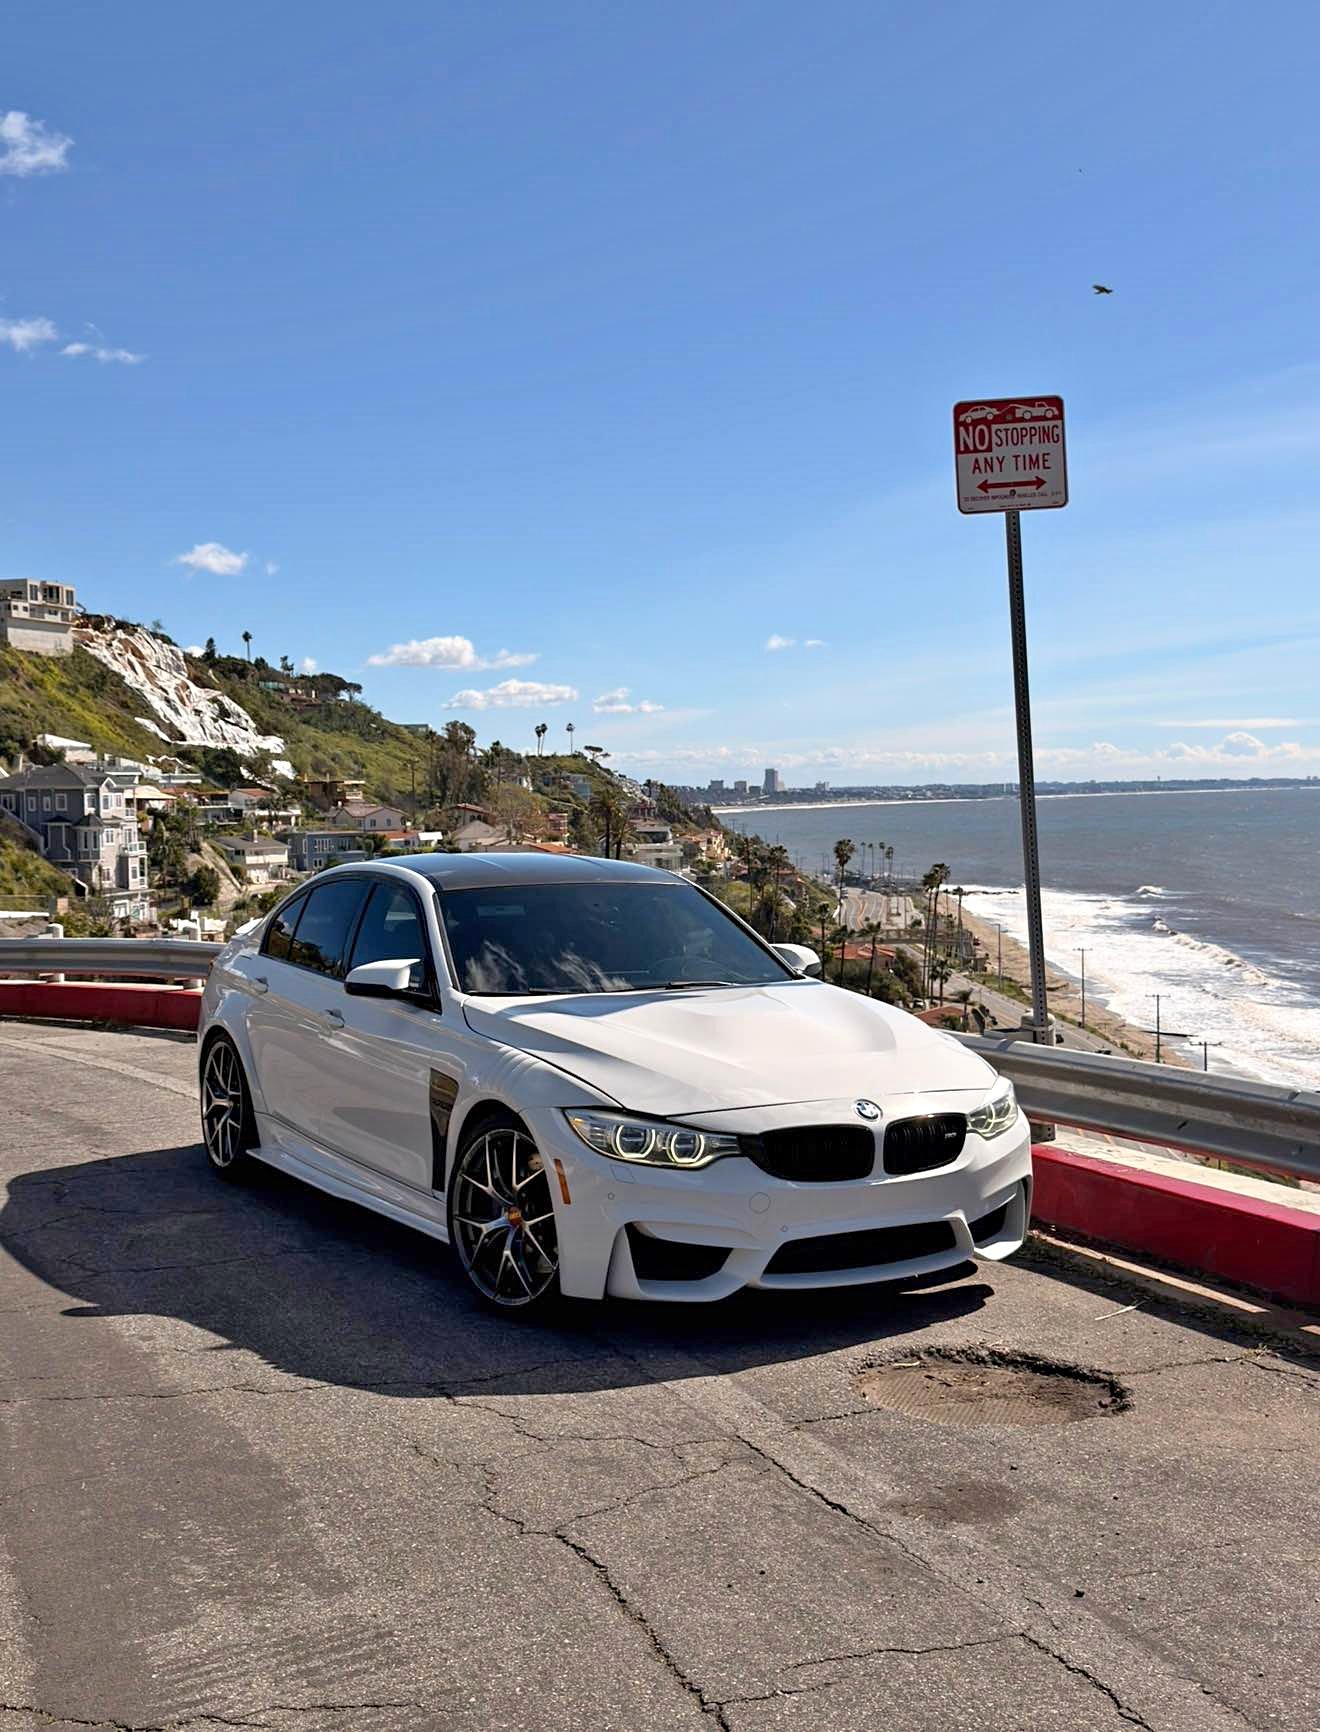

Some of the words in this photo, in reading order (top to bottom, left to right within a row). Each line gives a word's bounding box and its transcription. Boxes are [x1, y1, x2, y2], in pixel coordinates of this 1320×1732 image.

[959, 424, 989, 451] NO
[994, 424, 1060, 447] STOPPING
[972, 456, 1005, 474] ANY
[1013, 453, 1051, 470] TIME
